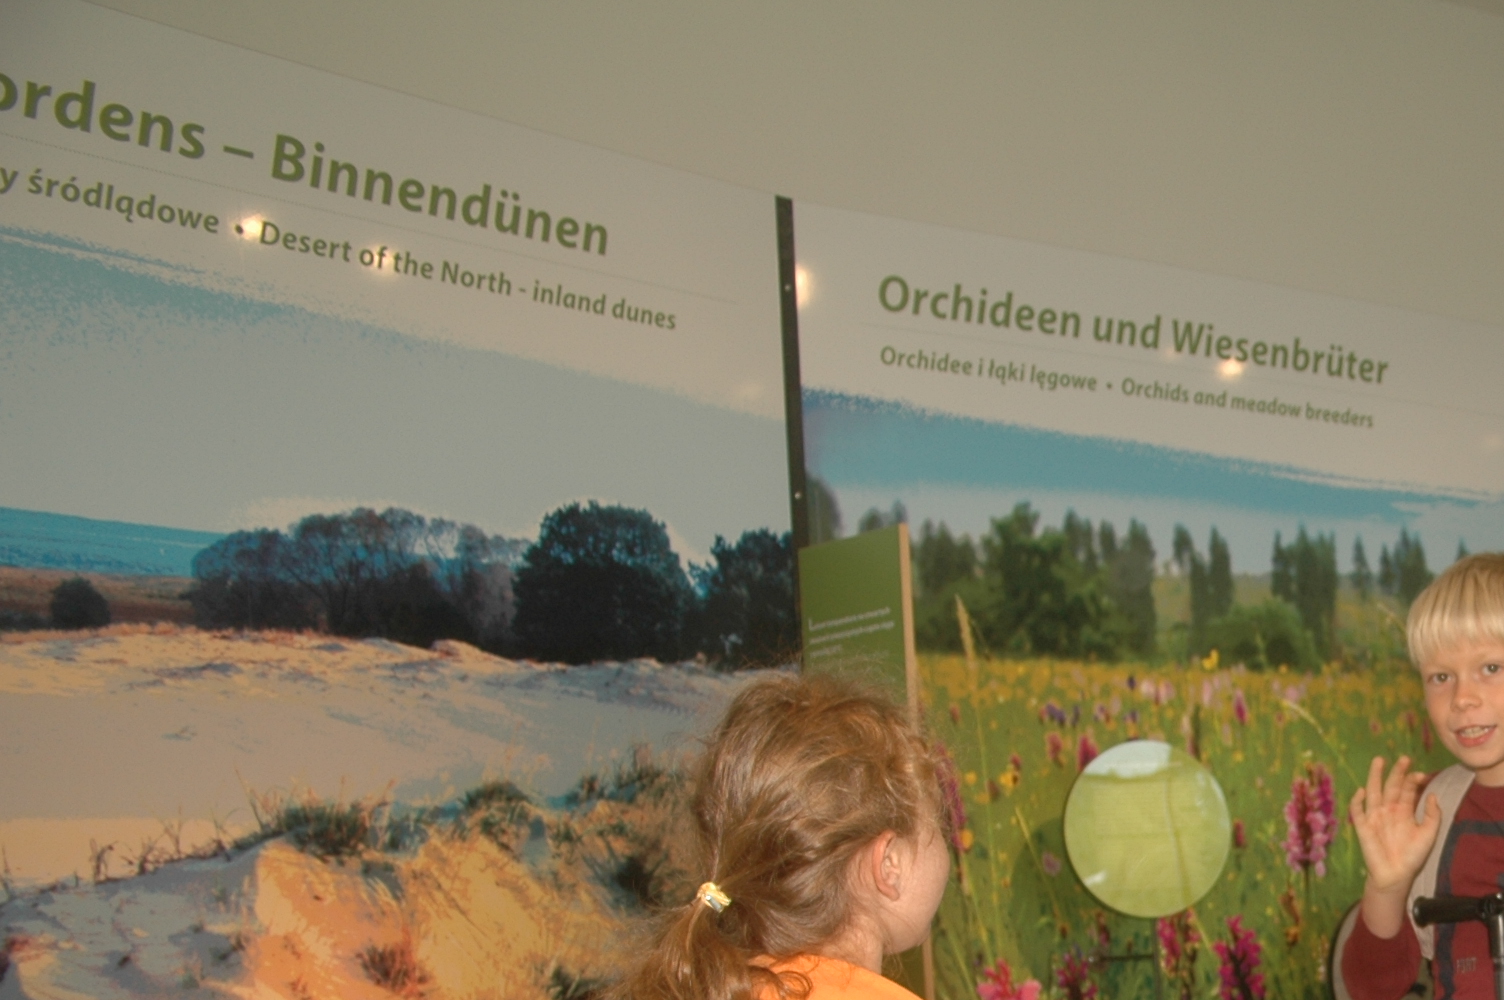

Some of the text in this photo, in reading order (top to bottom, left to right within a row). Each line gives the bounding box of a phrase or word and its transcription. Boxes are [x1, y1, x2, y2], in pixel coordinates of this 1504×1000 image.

[27, 168, 219, 234] śródlądowe
[259, 220, 352, 262] Desert
[359, 246, 388, 269] of
[393, 251, 434, 279] the
[441, 261, 511, 296] North
[533, 281, 606, 315] inland
[612, 298, 676, 330] dunes
[271, 133, 608, 256] Binnendünen
[878, 275, 1389, 384] Orchideen und Wiesenbrüter
[880, 345, 1374, 428] Orchidee i łąki lęgowe Orchids and meadow breeders
